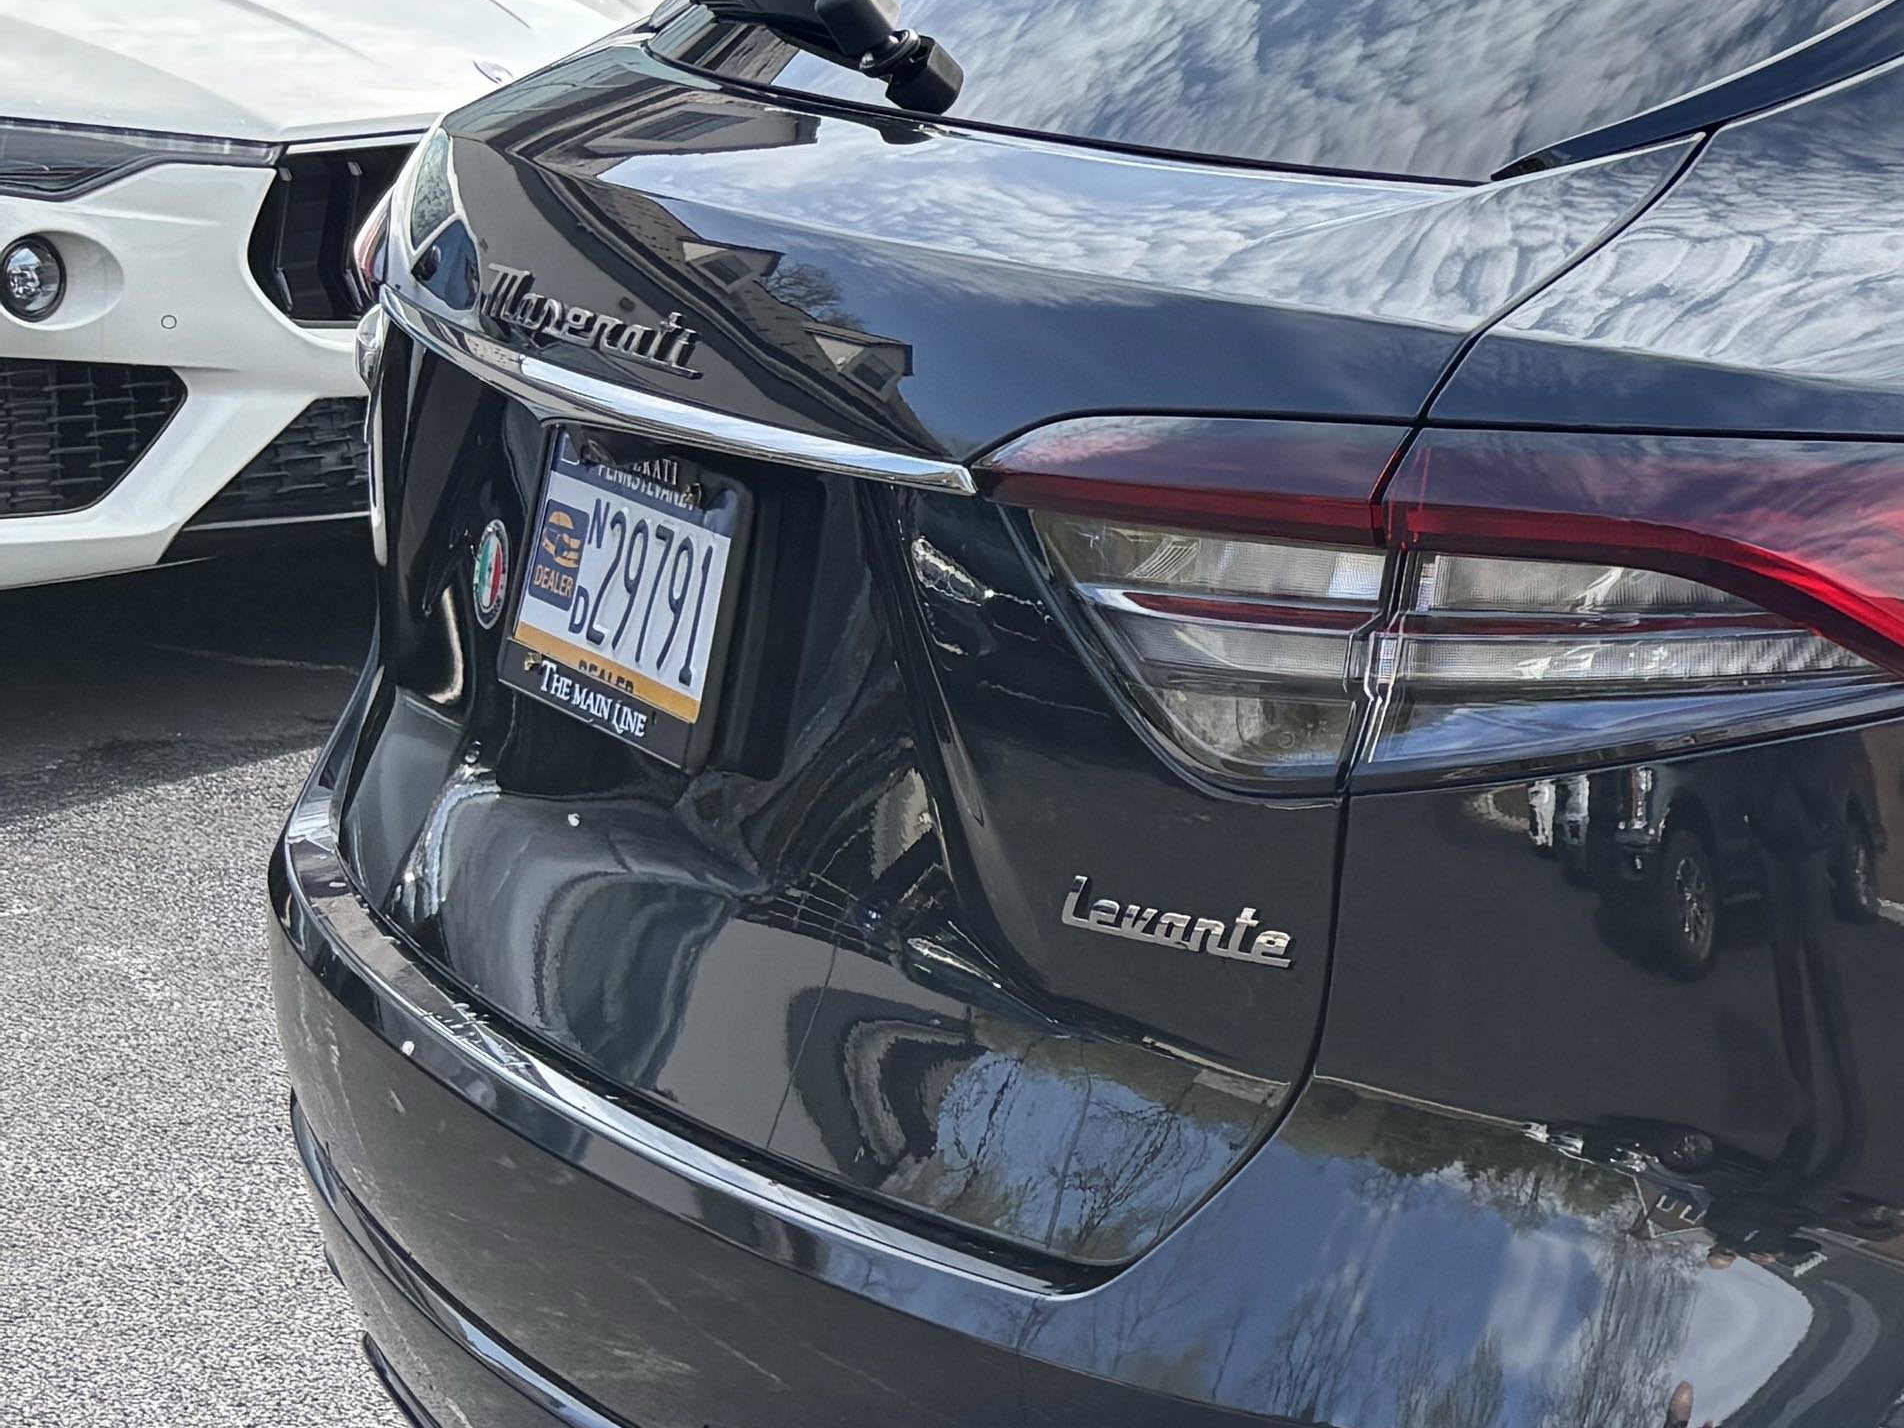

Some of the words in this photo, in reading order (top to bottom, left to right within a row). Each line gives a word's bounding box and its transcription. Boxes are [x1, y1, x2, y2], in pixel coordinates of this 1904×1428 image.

[481, 263, 704, 380] Maserati
[533, 566, 574, 598] DEALER
[585, 505, 714, 688] 29791
[540, 659, 573, 703] THE
[571, 682, 613, 722] MAIN
[613, 699, 648, 738] LINE
[1061, 874, 1293, 969] Levante
